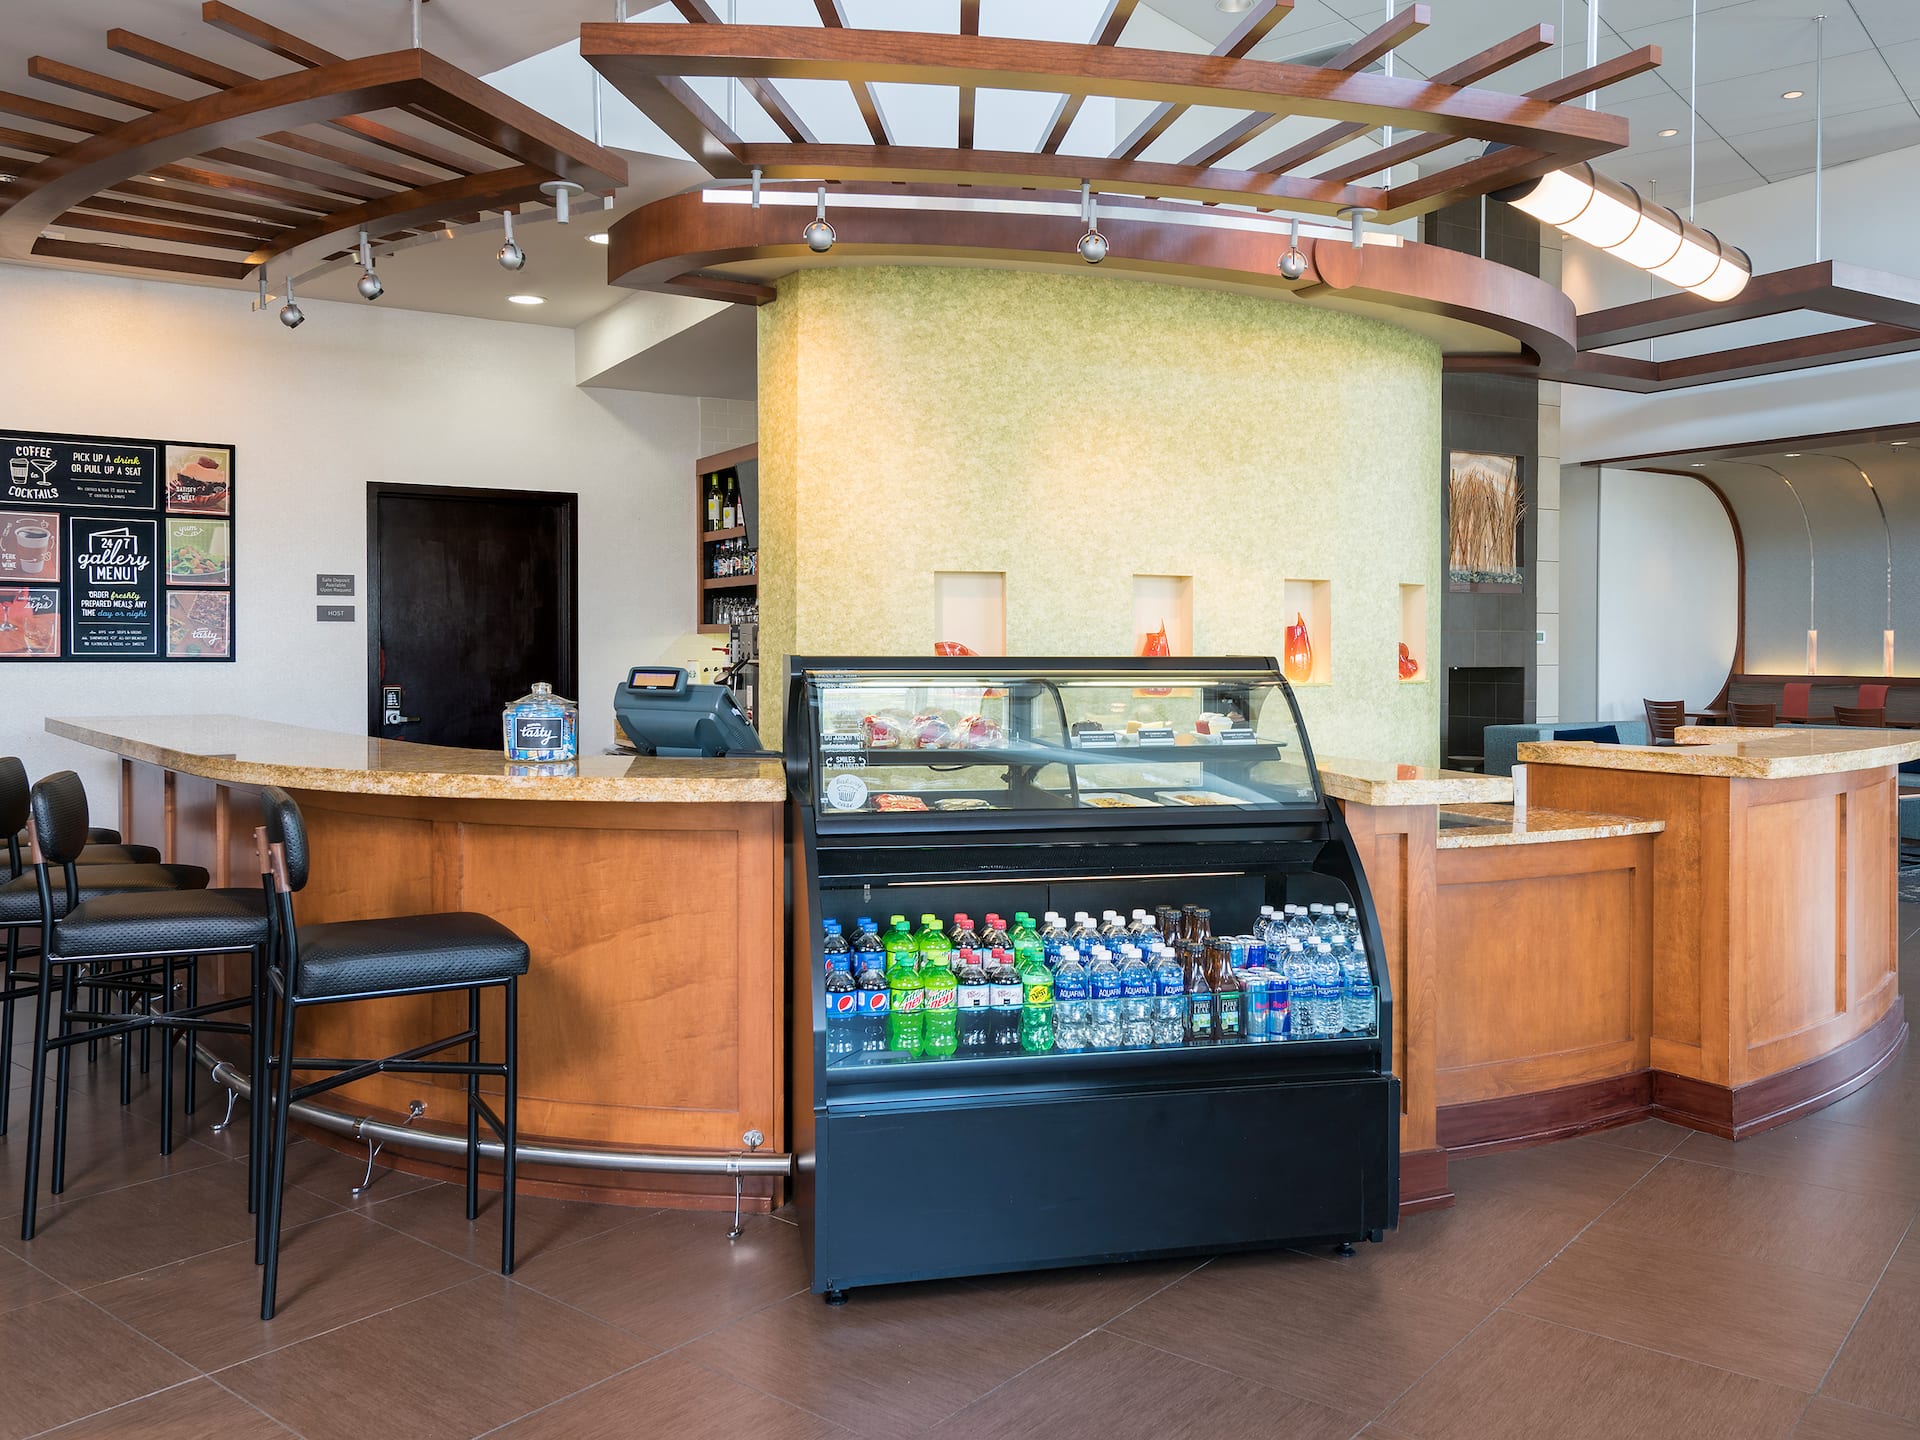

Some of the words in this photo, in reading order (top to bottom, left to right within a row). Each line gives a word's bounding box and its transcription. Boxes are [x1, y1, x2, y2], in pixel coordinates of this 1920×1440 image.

[16, 446, 52, 458] COFFEE
[73, 452, 90, 462] PICK
[93, 453, 103, 463] UP
[106, 454, 111, 463] A
[113, 456, 140, 465] drink
[71, 464, 81, 473] OR
[84, 465, 101, 474] PULL
[104, 466, 114, 474] UP
[117, 467, 122, 475] A
[125, 467, 142, 476] SEAT
[8, 486, 59, 499] COCKTAILS
[78, 539, 150, 571] gallery
[97, 566, 130, 580] MENU
[88, 590, 109, 599] ORDER
[110, 591, 141, 600] freshly
[80, 600, 112, 608] PREPARED
[113, 600, 133, 609] MEALS
[97, 610, 113, 619] day
[126, 610, 147, 619] night
[520, 727, 558, 745] tasty
[1059, 988, 1086, 998] AQUAFINA
[1098, 987, 1121, 997] AQUAFIN
[1124, 986, 1150, 995] AQUAFINA
